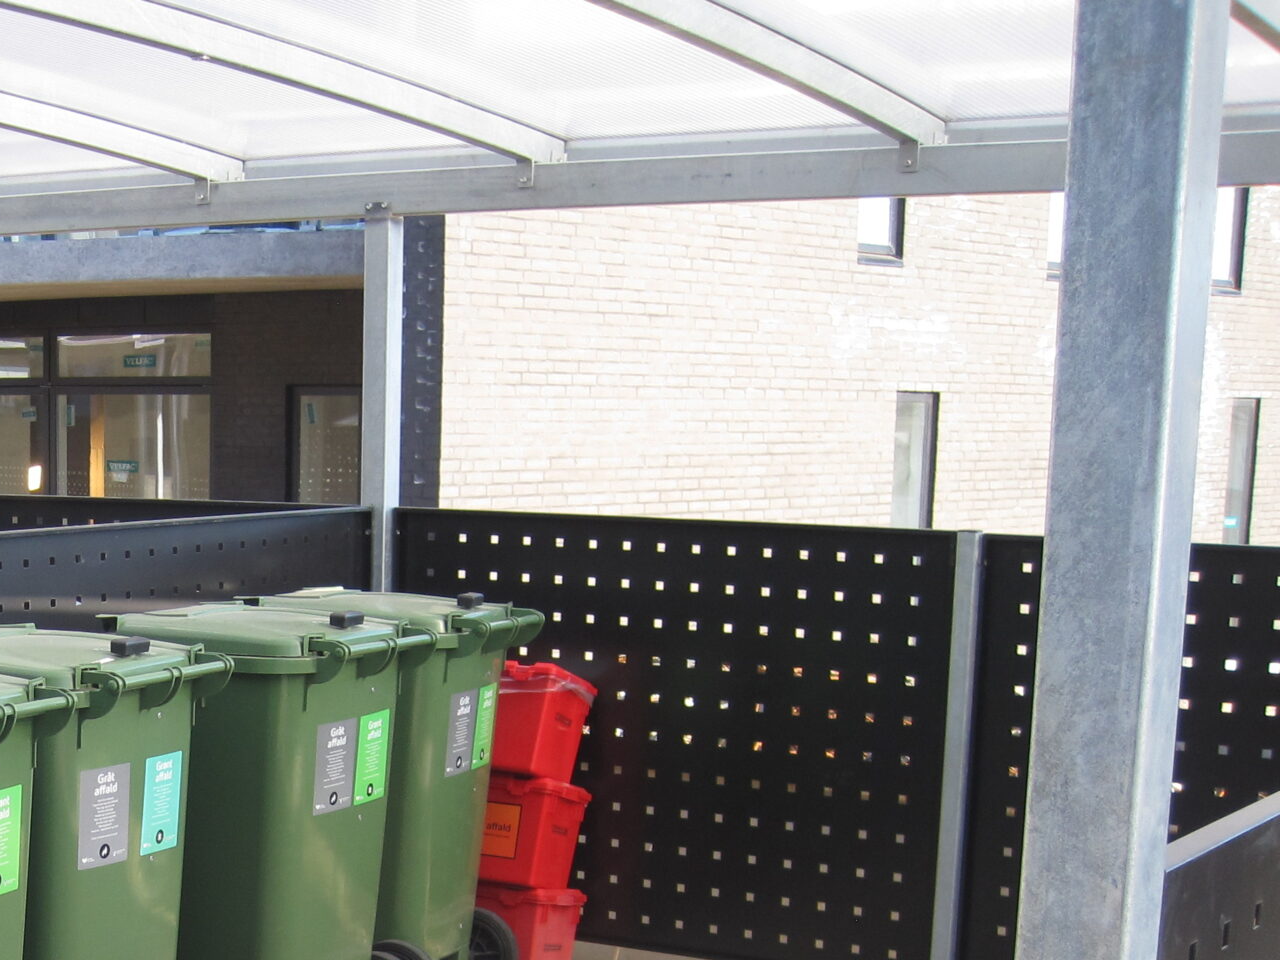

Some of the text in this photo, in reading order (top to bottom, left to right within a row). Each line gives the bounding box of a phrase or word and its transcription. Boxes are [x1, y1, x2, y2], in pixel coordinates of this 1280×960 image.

[330, 726, 345, 737] Gråt
[327, 736, 347, 748] affald
[98, 772, 115, 784] Gråt
[155, 770, 172, 782] affald
[94, 782, 118, 796] affald
[486, 823, 511, 833] affald
